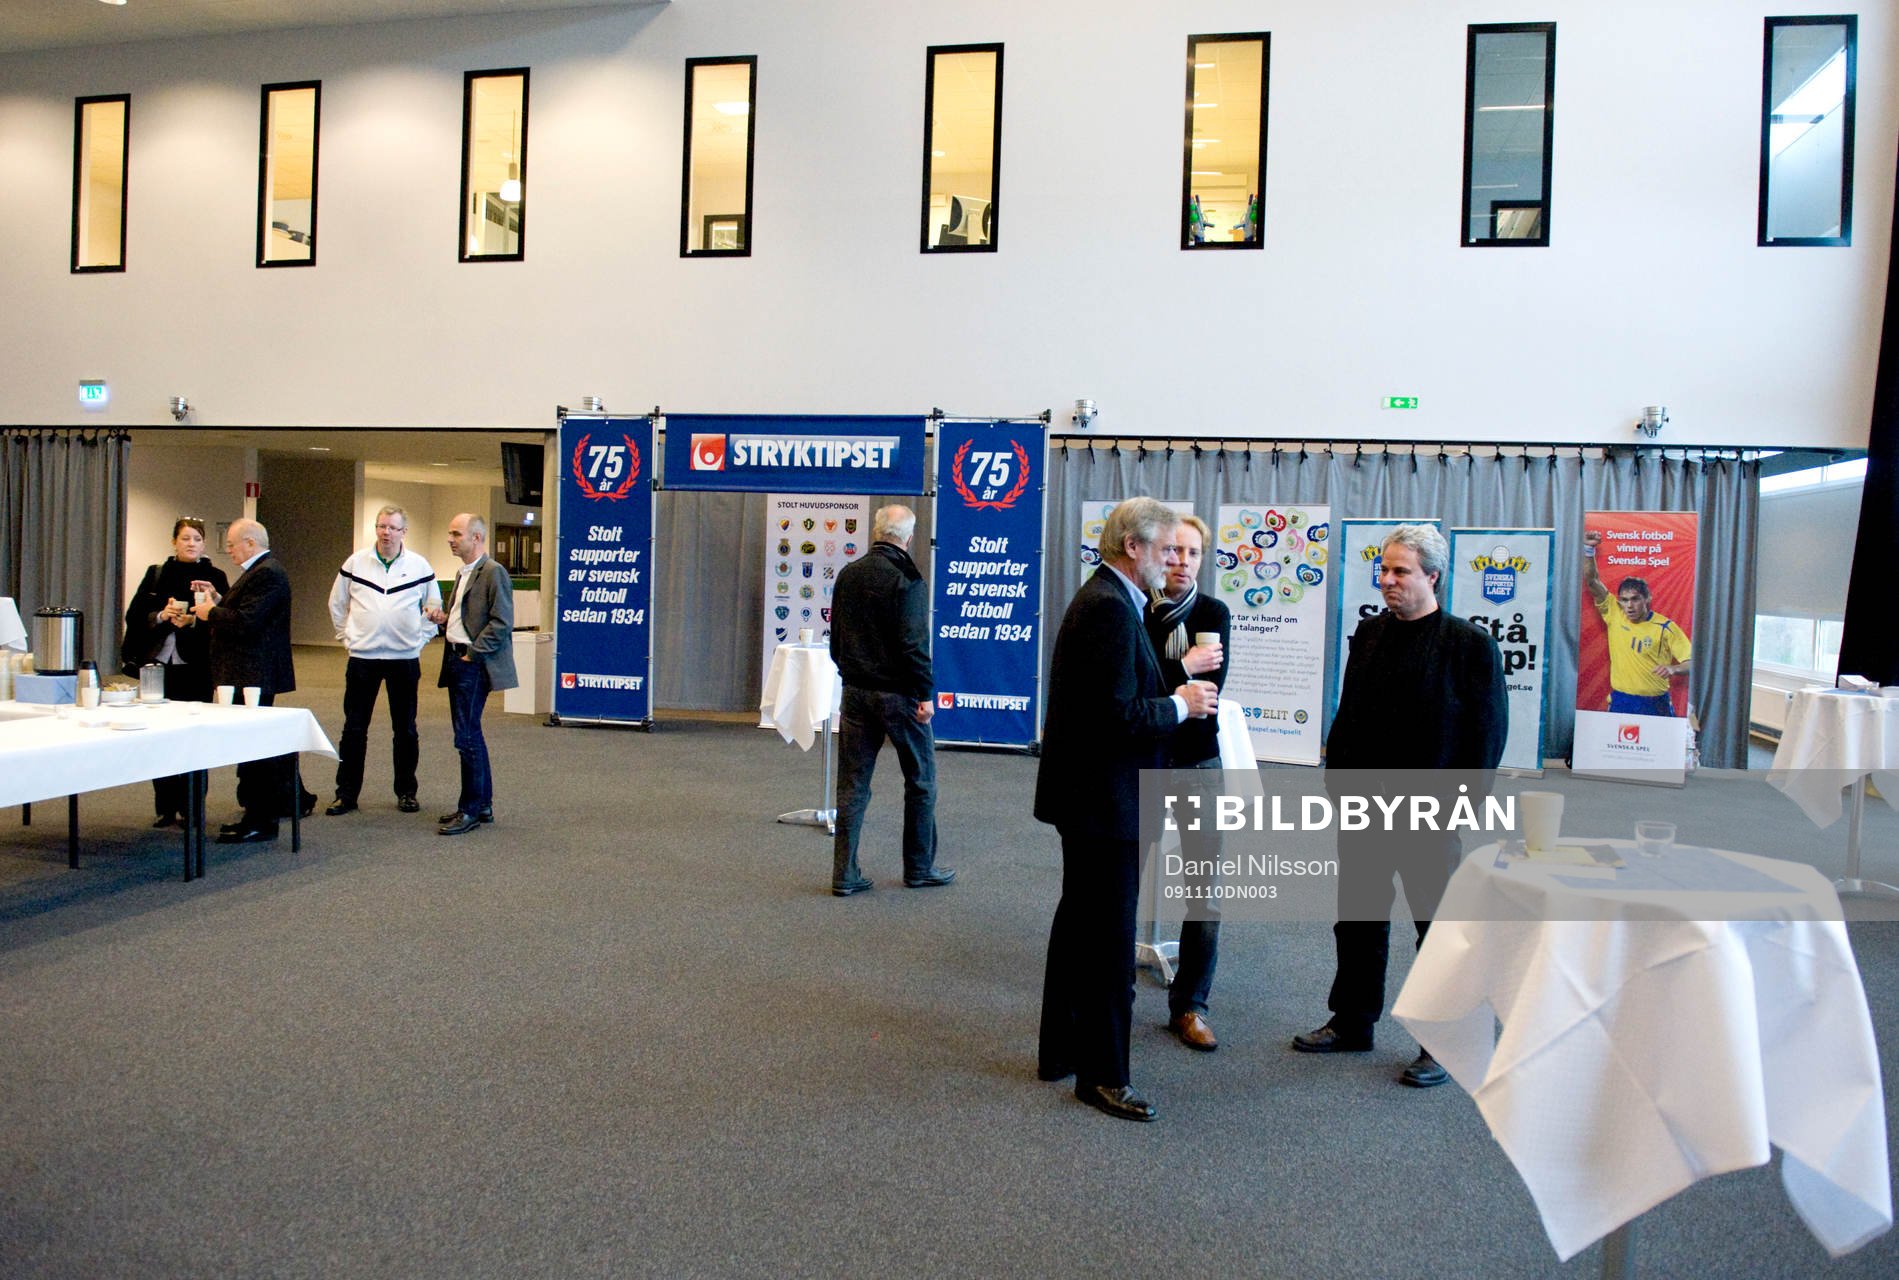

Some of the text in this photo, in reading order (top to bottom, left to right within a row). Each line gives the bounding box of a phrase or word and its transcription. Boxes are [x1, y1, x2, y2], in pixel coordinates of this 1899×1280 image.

[588, 446, 625, 479] 75
[733, 439, 895, 469] STRYKTIPSET
[969, 452, 1013, 487] 75
[599, 478, 613, 492] år
[982, 487, 998, 501] år
[799, 502, 859, 511] HUVUDSPONSOR
[587, 525, 623, 542] Stolt
[1606, 530, 1674, 541] Svensk fotboll
[968, 536, 1009, 554] Stolt
[1616, 543, 1662, 554] vinner på
[569, 547, 641, 566] supporter
[1607, 555, 1670, 567] Svenska Spel
[568, 567, 641, 584] av svensk
[947, 559, 1029, 579] supporter
[580, 586, 628, 604] fotboll
[946, 581, 1028, 598] av svensk
[1486, 587, 1512, 596] LAGET
[562, 607, 645, 625] sedan 1934
[960, 601, 1014, 619] fotboll
[1237, 614, 1249, 622] tar
[1251, 614, 1259, 622] vi
[1261, 614, 1282, 623] hand
[939, 622, 1033, 642] sedan 1934
[1239, 624, 1280, 634] talanger?
[1503, 645, 1537, 676] p!
[578, 676, 642, 691] STRYKTIPSET
[956, 695, 1031, 712] STRYKTIPSET
[1262, 708, 1289, 720] ELIT
